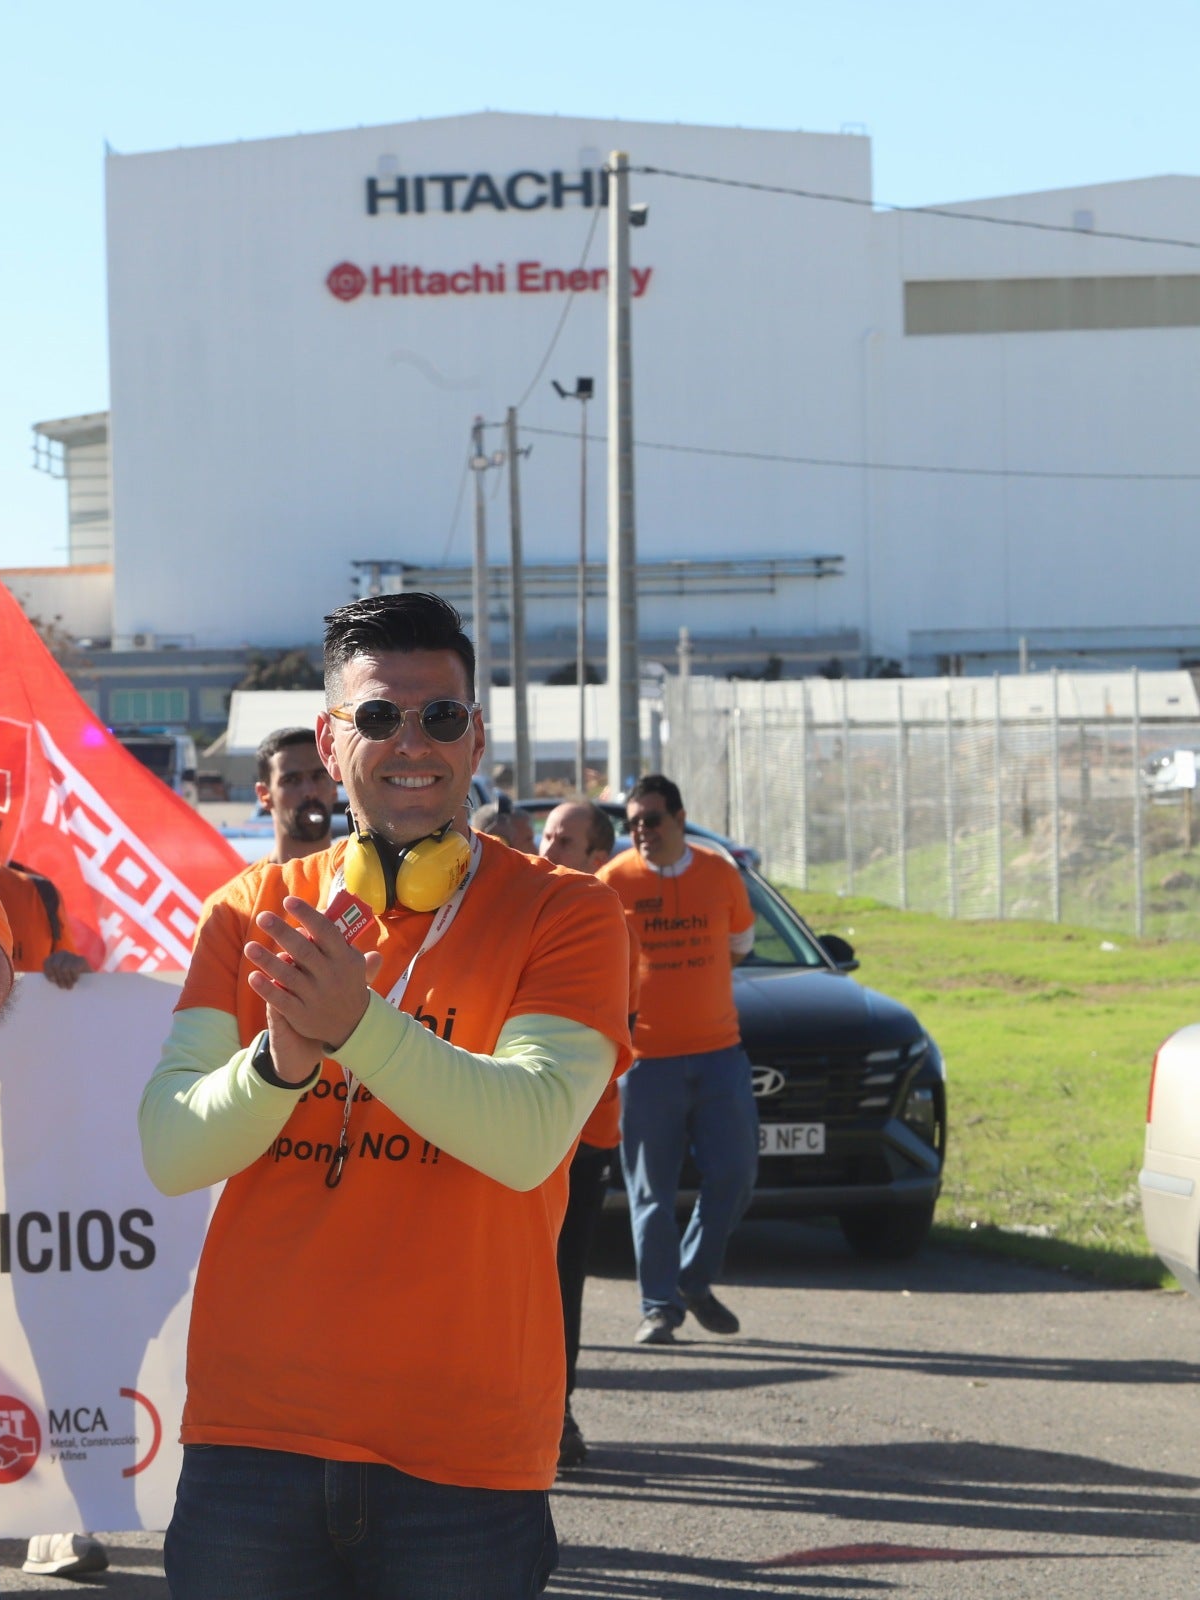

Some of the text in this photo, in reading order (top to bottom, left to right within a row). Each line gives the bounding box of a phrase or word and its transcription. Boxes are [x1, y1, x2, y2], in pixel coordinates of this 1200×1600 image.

[365, 168, 610, 216] HITACHI
[371, 262, 652, 298] Hitachi Enery
[358, 1132, 411, 1162] NO
[776, 1127, 819, 1151] NFC
[48, 1407, 109, 1434] MCA
[80, 1434, 141, 1448] Construcción
